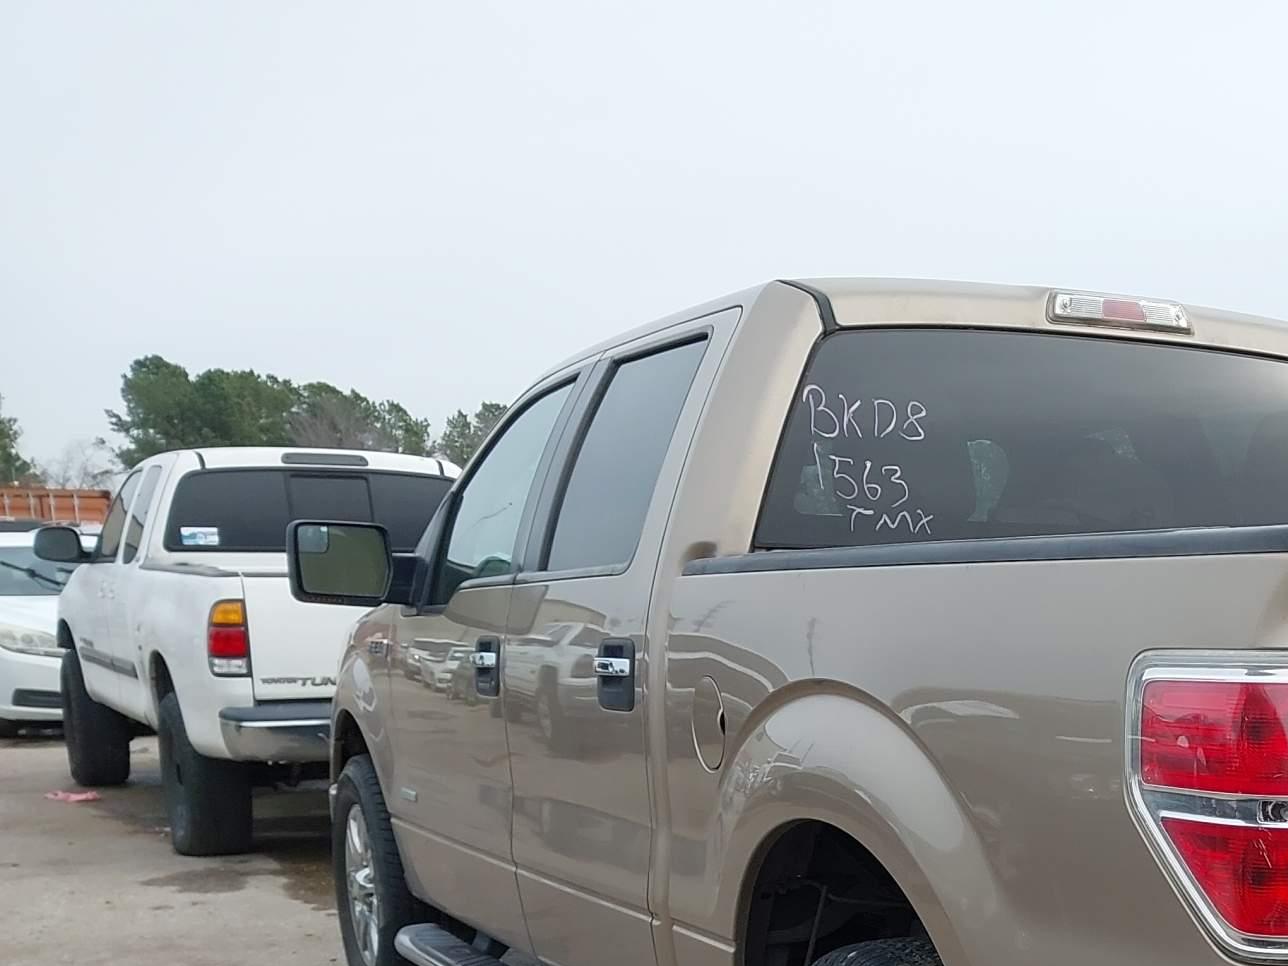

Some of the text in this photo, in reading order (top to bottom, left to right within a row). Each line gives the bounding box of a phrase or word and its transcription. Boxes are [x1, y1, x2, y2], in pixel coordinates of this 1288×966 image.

[802, 384, 928, 441] BKD8
[846, 504, 934, 535] TMX
[298, 675, 337, 687] TUN
